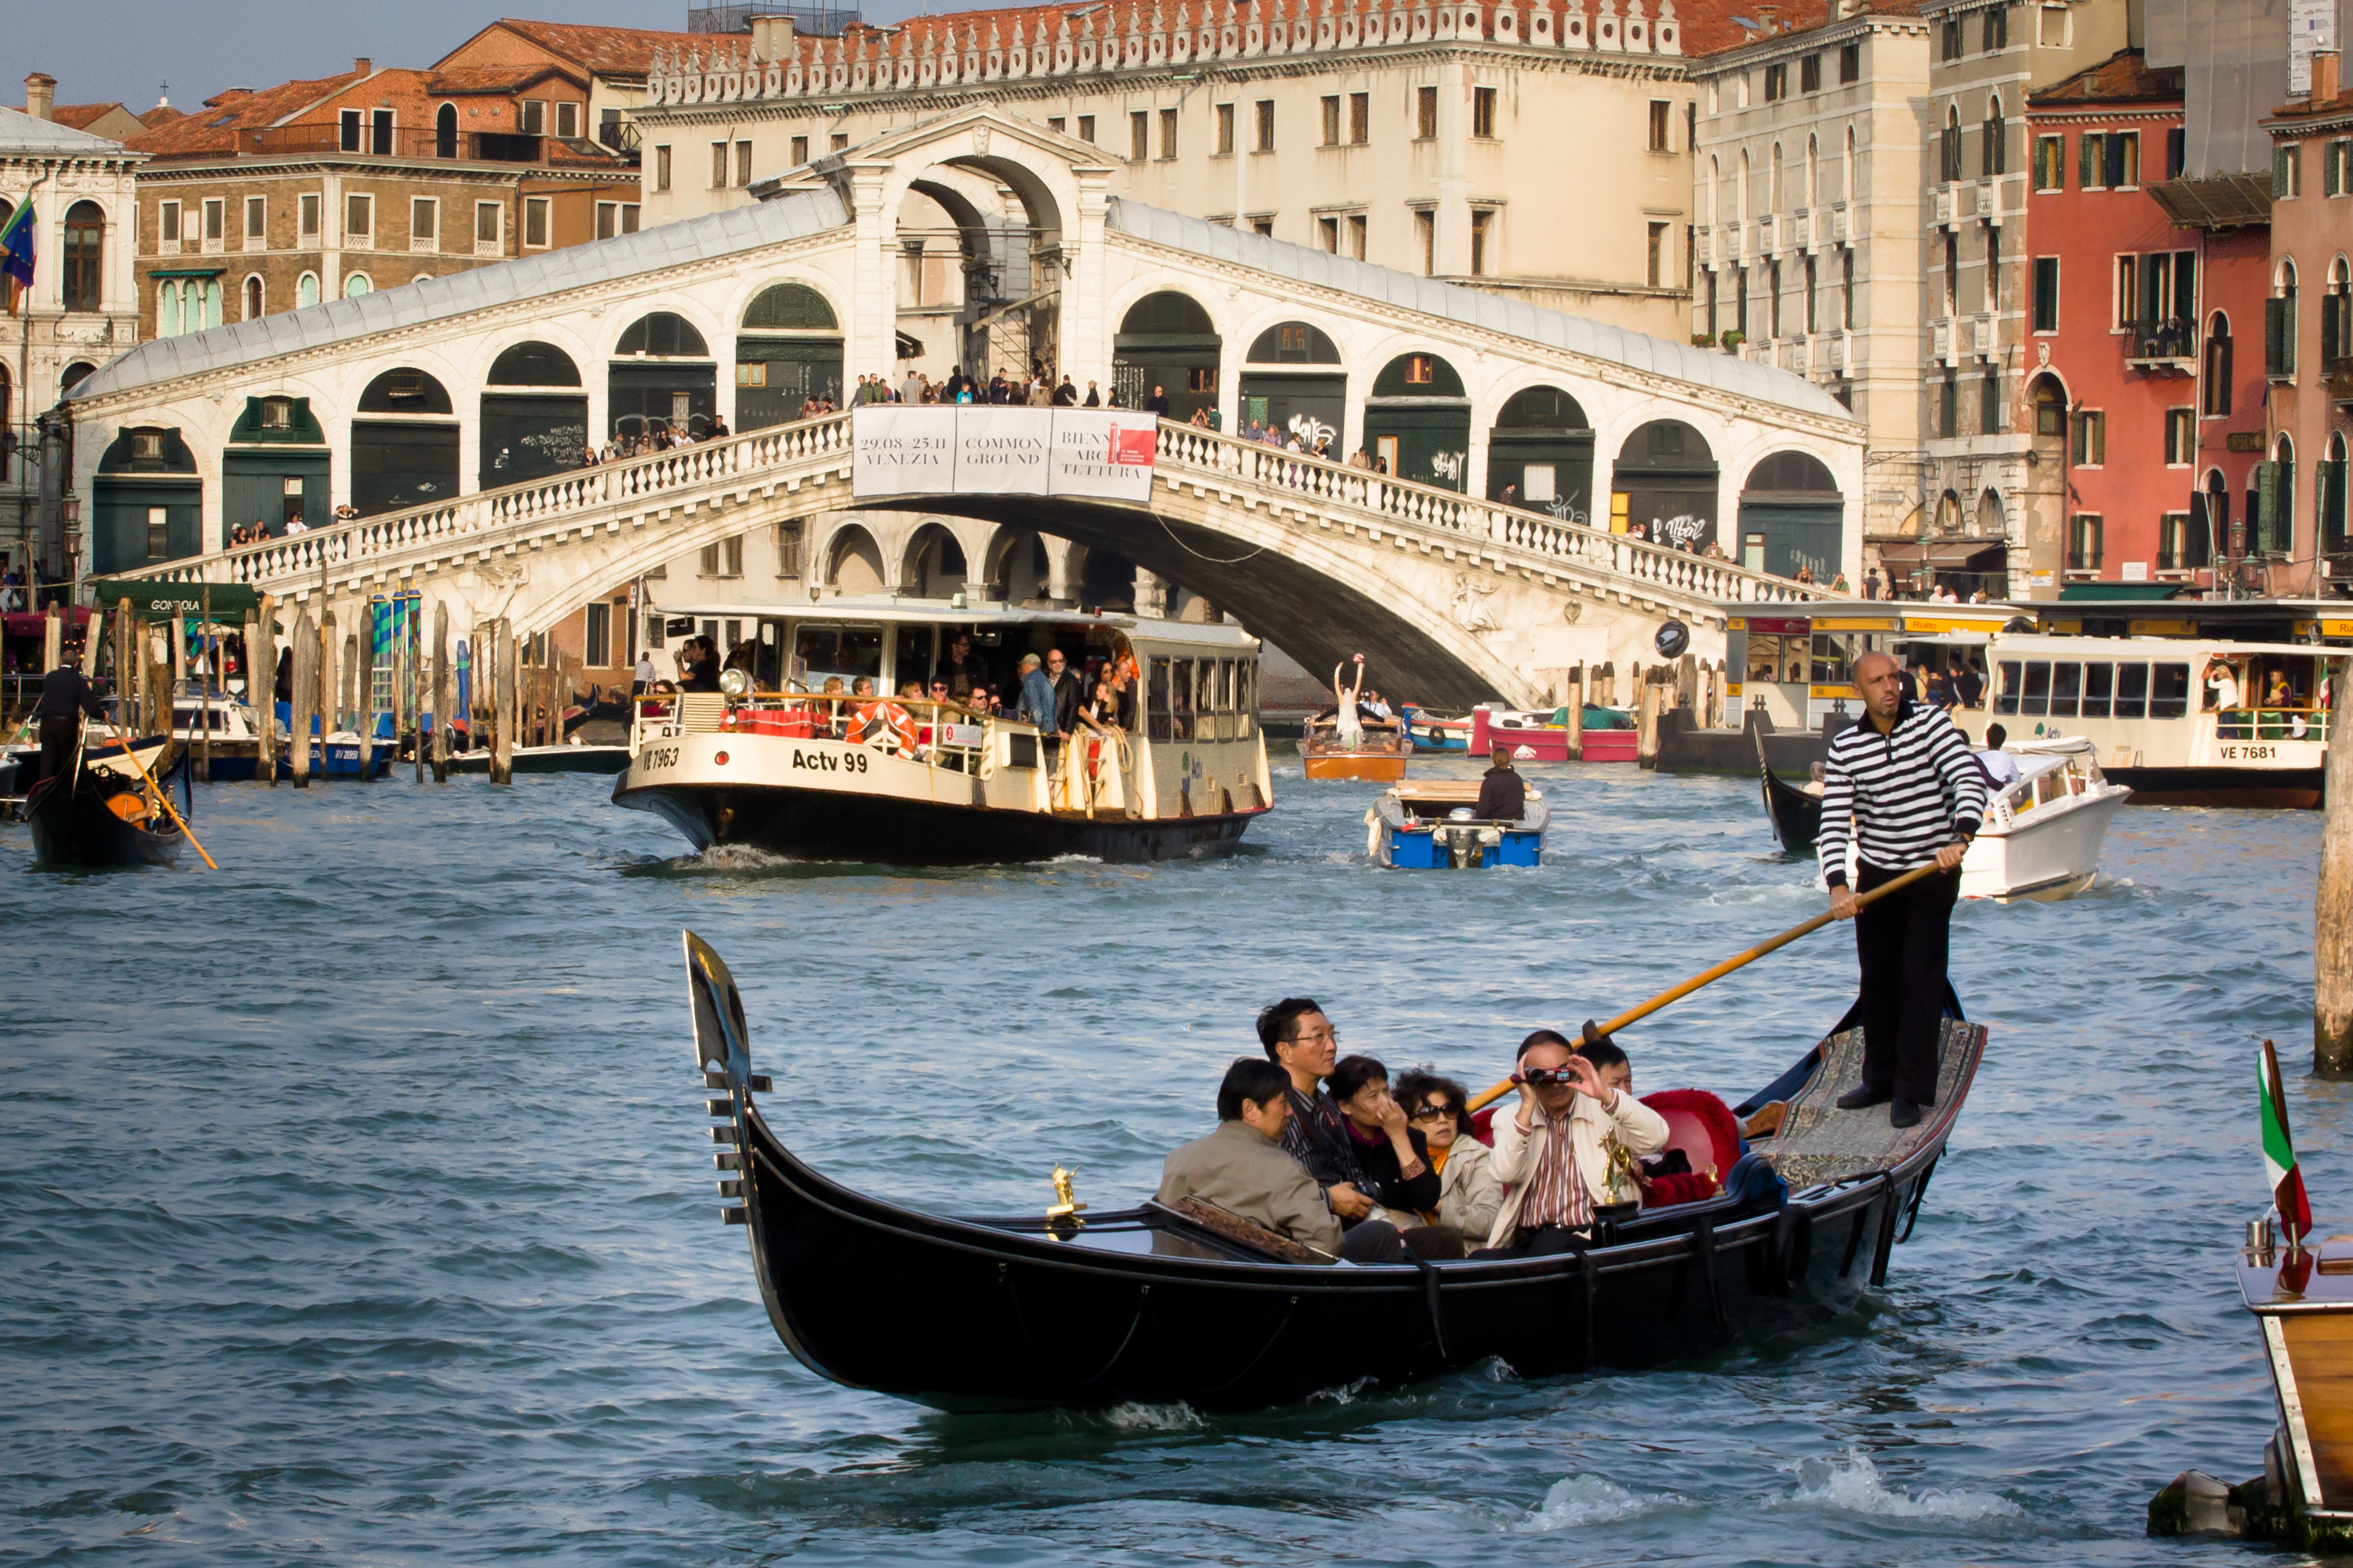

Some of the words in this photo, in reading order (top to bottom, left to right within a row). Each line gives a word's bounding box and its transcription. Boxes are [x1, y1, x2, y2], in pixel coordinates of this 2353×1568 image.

[966, 438, 1042, 449] COMMON
[867, 453, 939, 465] VENEZIA
[967, 453, 1040, 465] GROUND
[1061, 463, 1140, 479] TETTURA
[151, 600, 199, 610] GONOLA
[1913, 621, 1937, 629] Rialto
[653, 747, 679, 769] 7963
[2221, 747, 2236, 759] VE
[2242, 747, 2276, 759] 7681
[793, 749, 838, 772] Actv
[844, 752, 868, 774] 99
